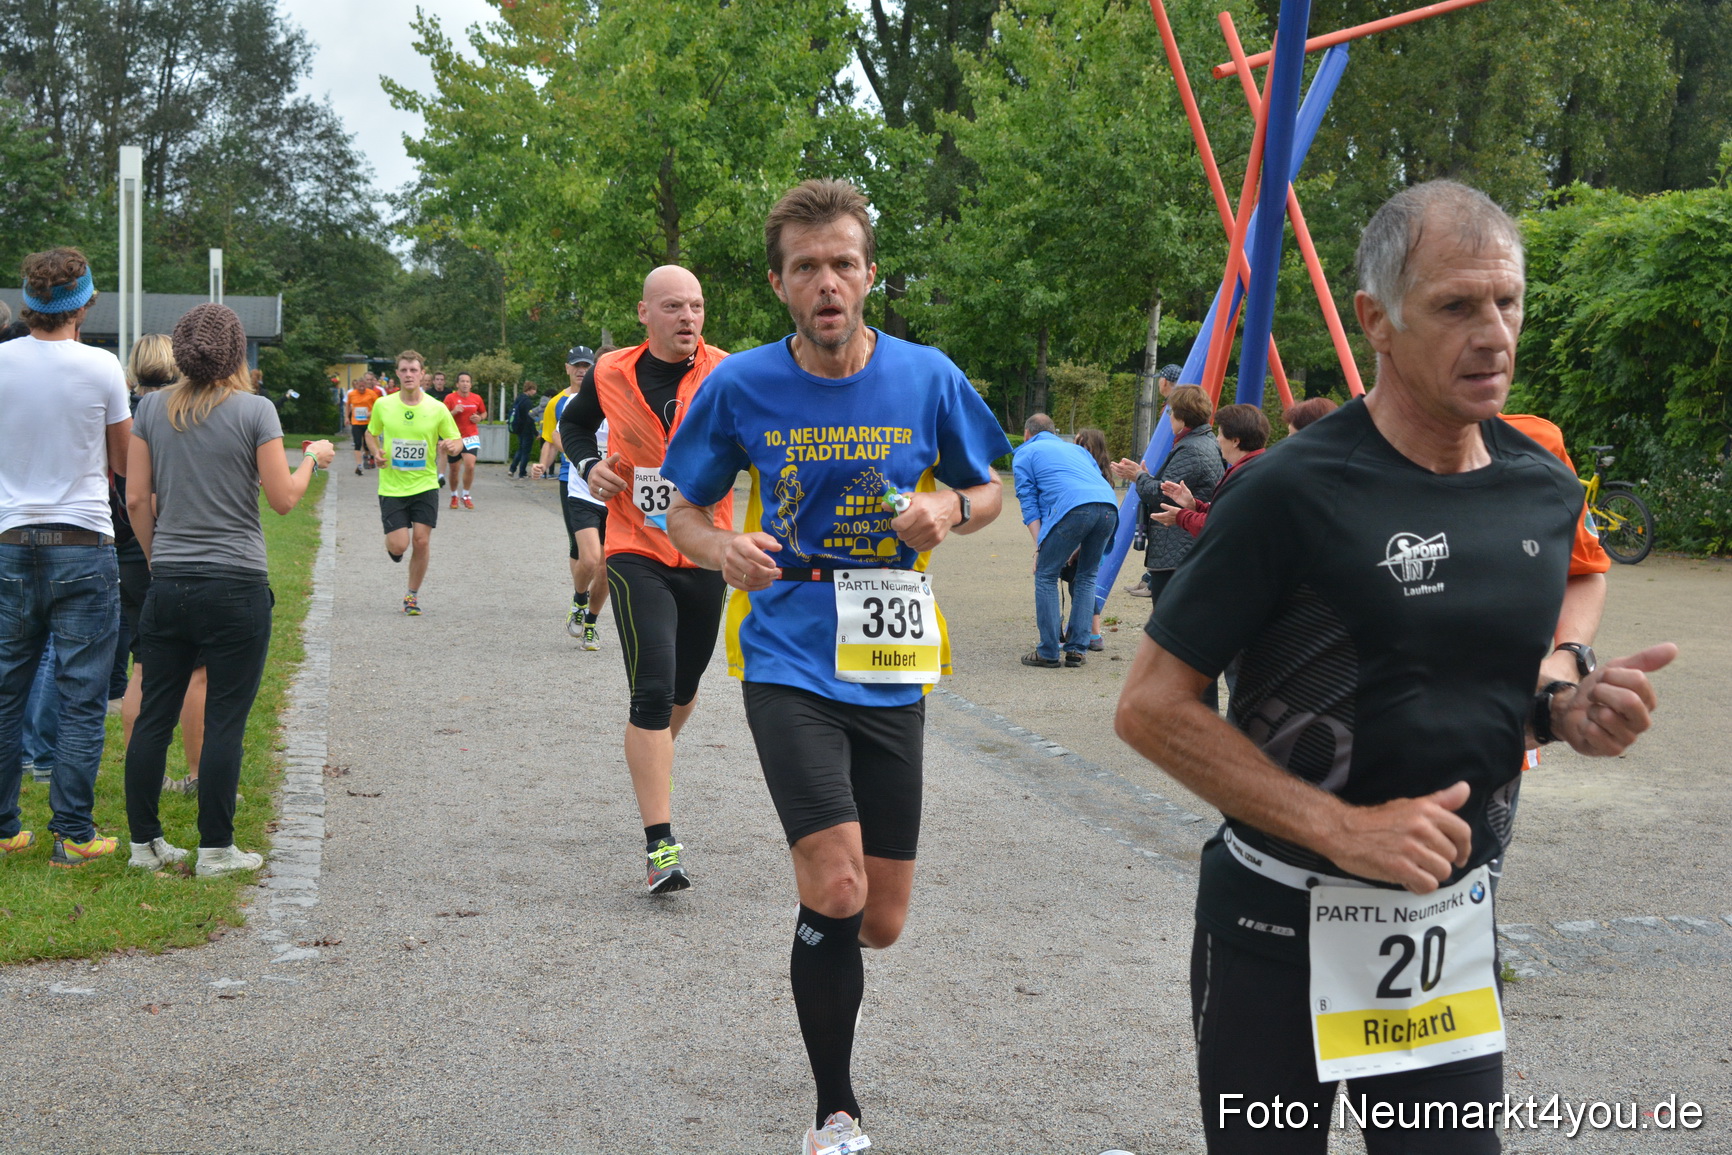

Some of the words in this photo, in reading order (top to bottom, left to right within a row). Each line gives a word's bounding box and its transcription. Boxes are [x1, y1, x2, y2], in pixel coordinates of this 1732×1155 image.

[764, 430, 786, 447] 10.
[789, 426, 913, 445] NEUMARKTER
[395, 446, 425, 459] 2529
[785, 444, 891, 462] STADTLAUF
[635, 474, 659, 482] PARTL
[640, 485, 677, 512] 33
[1397, 538, 1446, 559] SPORT
[838, 580, 879, 592] PARTL
[881, 580, 921, 593] Neumarkt
[1403, 582, 1445, 597] Lauftreff
[862, 597, 924, 640] 339
[872, 650, 917, 667] Hubert
[1316, 905, 1388, 923] PARTL
[1394, 891, 1465, 923] Neumarkt
[1376, 925, 1447, 999] 20
[1319, 999, 1328, 1011] B
[1364, 1005, 1456, 1045] Richard
